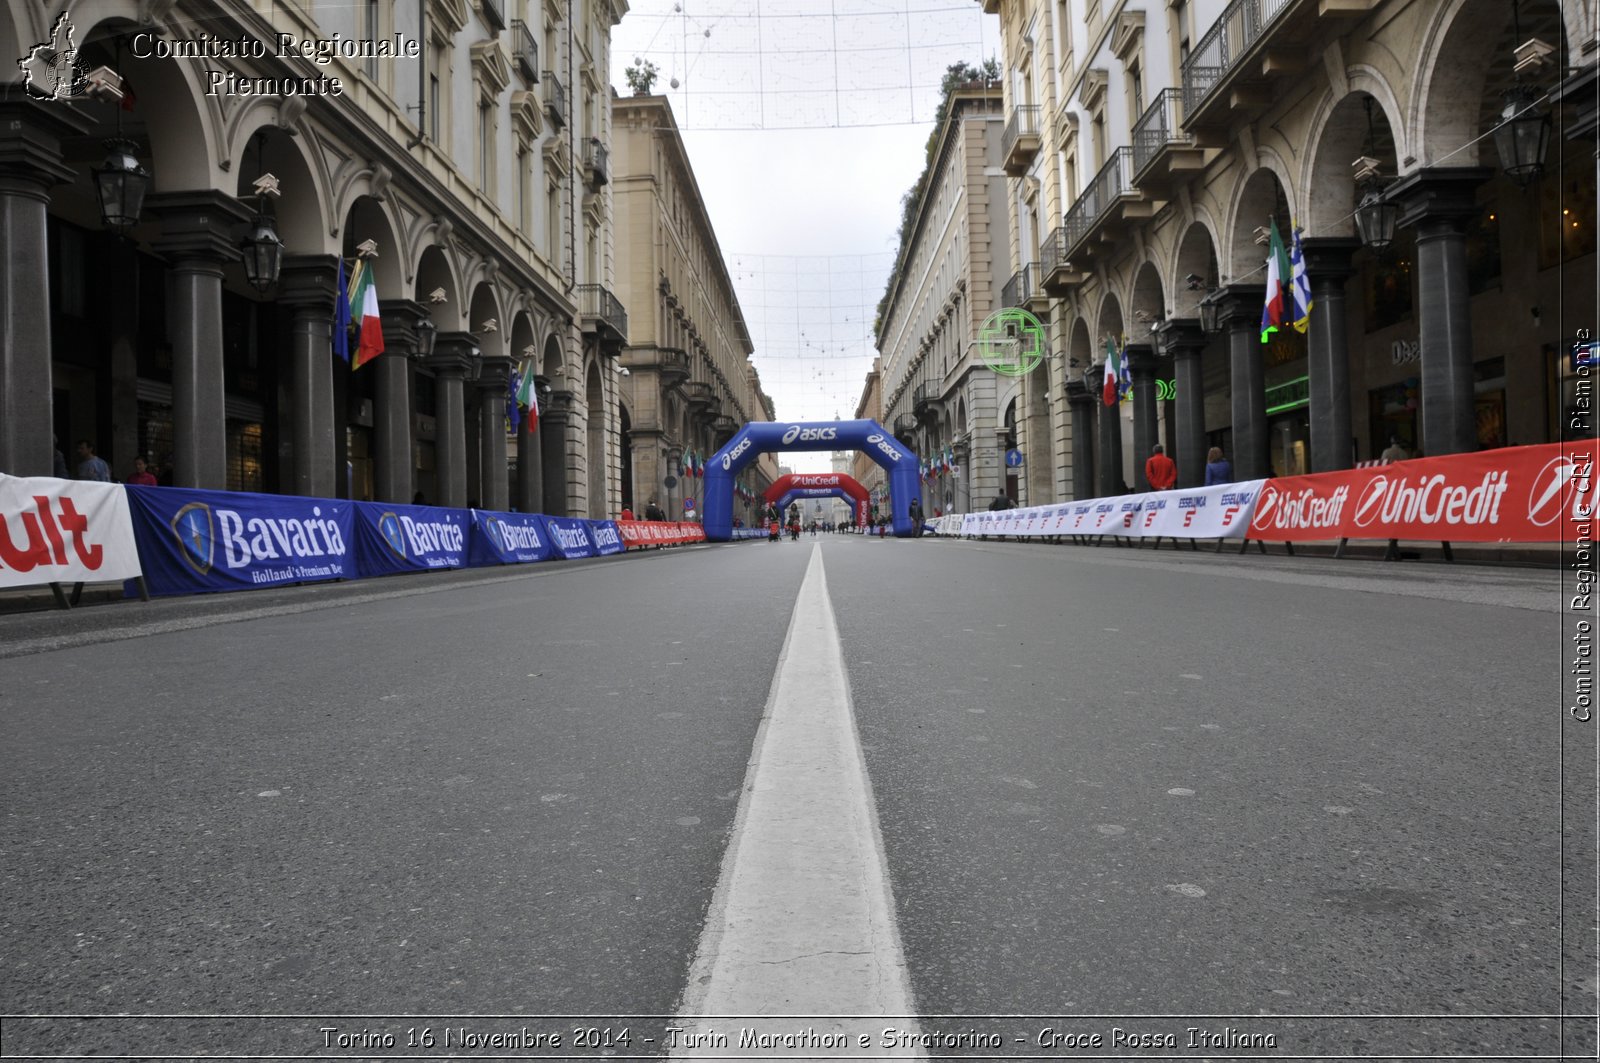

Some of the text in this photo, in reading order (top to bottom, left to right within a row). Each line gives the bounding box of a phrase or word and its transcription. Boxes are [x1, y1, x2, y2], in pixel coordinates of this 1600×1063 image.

[730, 437, 751, 460] asics
[800, 427, 837, 440] asics
[878, 440, 902, 462] asics
[802, 476, 839, 485] UniCredit
[1275, 484, 1349, 529] UniCredit
[1382, 470, 1508, 525] UniCredit
[0, 496, 103, 573] ult
[216, 506, 346, 568] Bavaria
[400, 514, 463, 556] Bavaria
[498, 519, 542, 551] Bavaria
[252, 566, 300, 583] Holland's
[299, 565, 331, 577] Premium
